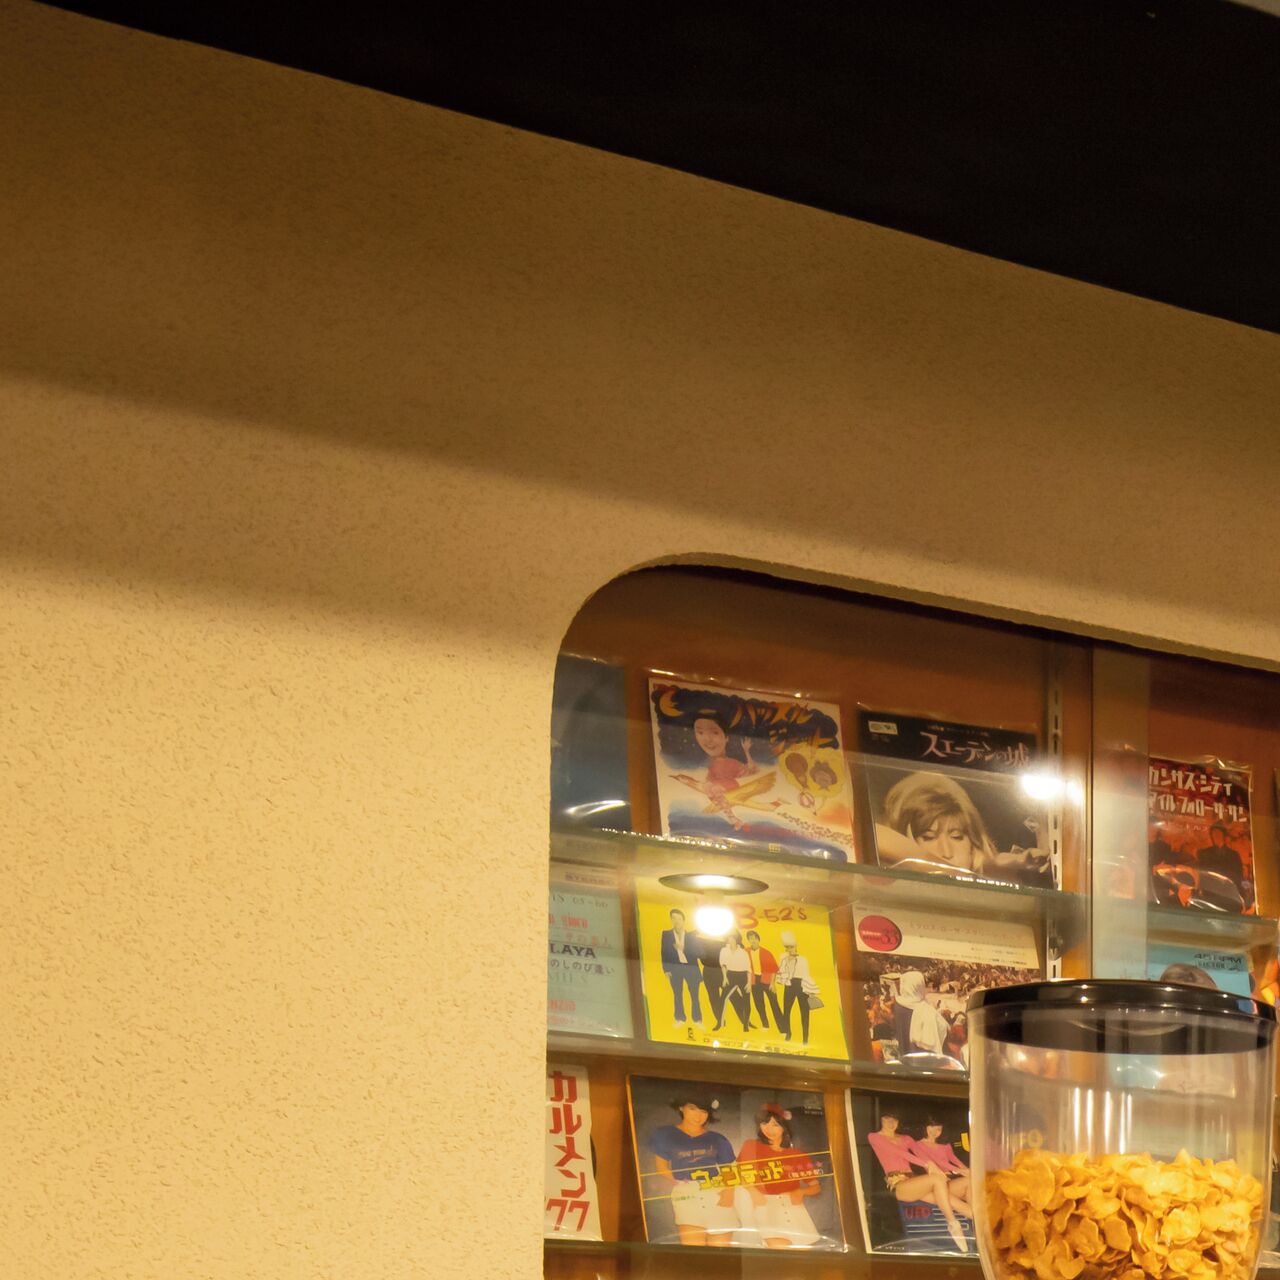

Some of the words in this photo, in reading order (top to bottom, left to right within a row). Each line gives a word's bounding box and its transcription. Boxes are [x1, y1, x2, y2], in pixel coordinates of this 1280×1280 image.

[690, 1160, 784, 1190] ウォンテッド
